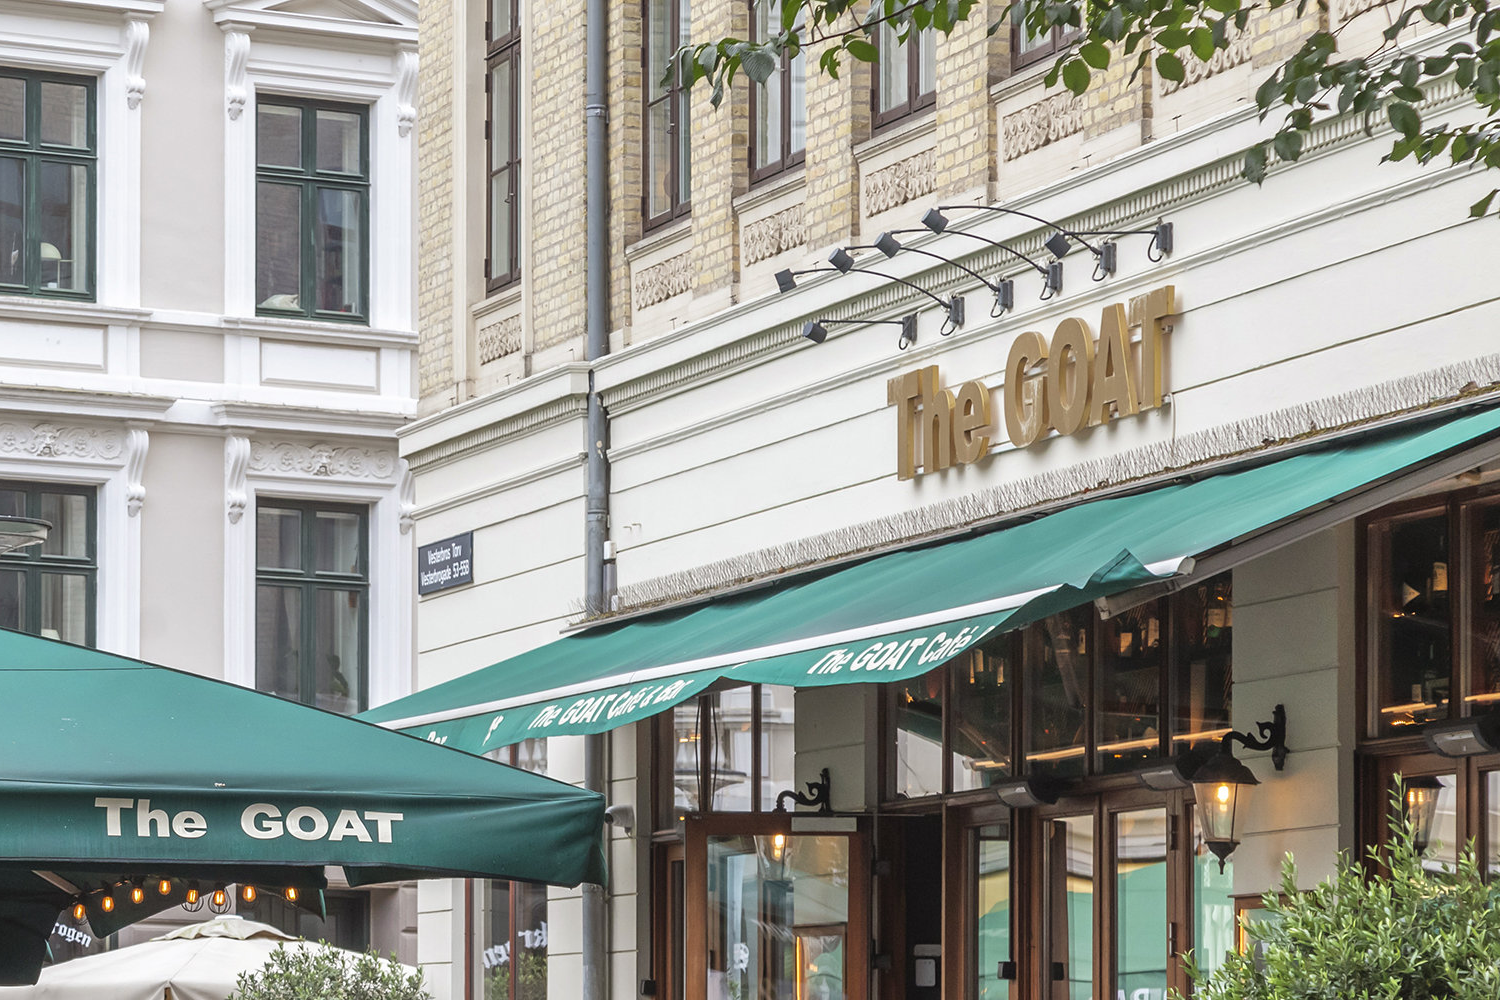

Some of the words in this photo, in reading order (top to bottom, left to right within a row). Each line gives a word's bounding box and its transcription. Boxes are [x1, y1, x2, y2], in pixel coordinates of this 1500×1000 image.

[887, 365, 991, 481] The
[1004, 285, 1175, 447] GOAT
[452, 543, 463, 558] Torv
[420, 564, 452, 586] Vesterbrogade
[807, 649, 855, 675] The
[850, 637, 928, 671] GOAT
[917, 626, 979, 665] Café
[527, 704, 563, 730] The
[558, 694, 618, 726] GOAT
[607, 686, 654, 720] Café
[652, 679, 695, 705] Bar
[94, 797, 208, 838] The
[240, 803, 404, 843] GOAT
[51, 922, 92, 948] rogen
